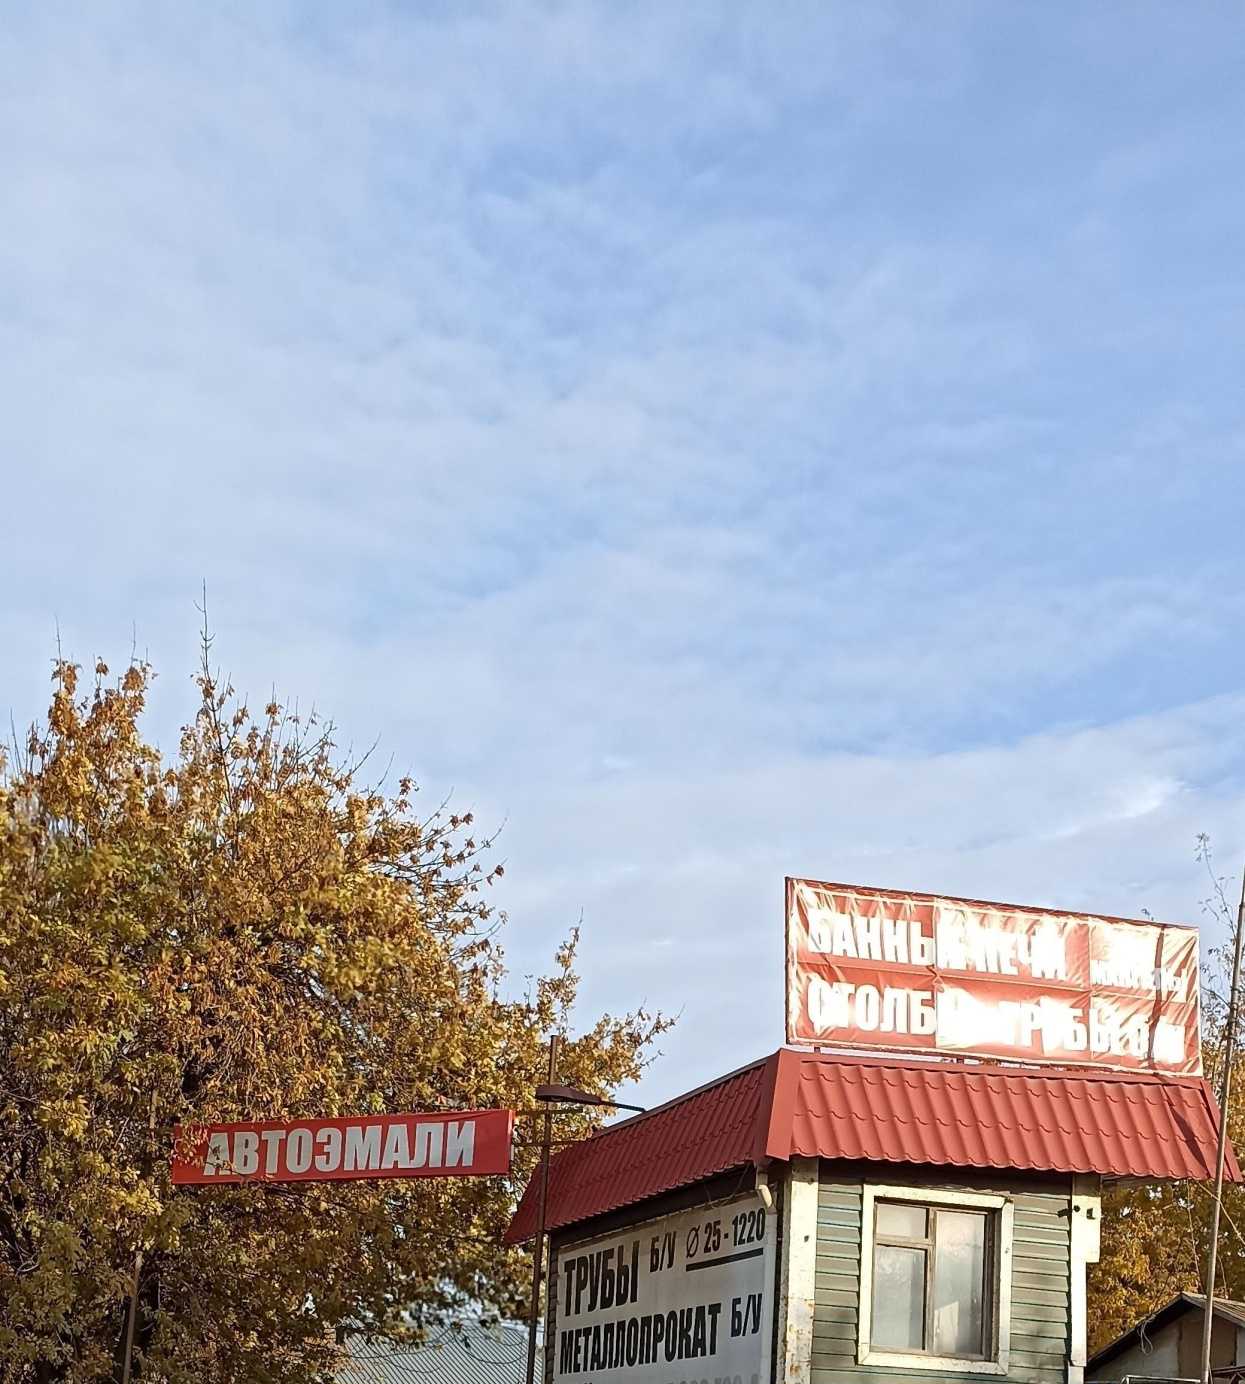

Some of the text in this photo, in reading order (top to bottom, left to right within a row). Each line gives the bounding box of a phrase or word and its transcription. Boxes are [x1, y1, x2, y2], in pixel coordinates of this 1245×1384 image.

[203, 1120, 476, 1176] АВТОЭМАЛИ
[564, 1240, 640, 1316] ТРУБЫ
[650, 1231, 676, 1273] Б/У
[560, 1293, 763, 1374] МЕТАЛЛОПРОКАТ Б/У
